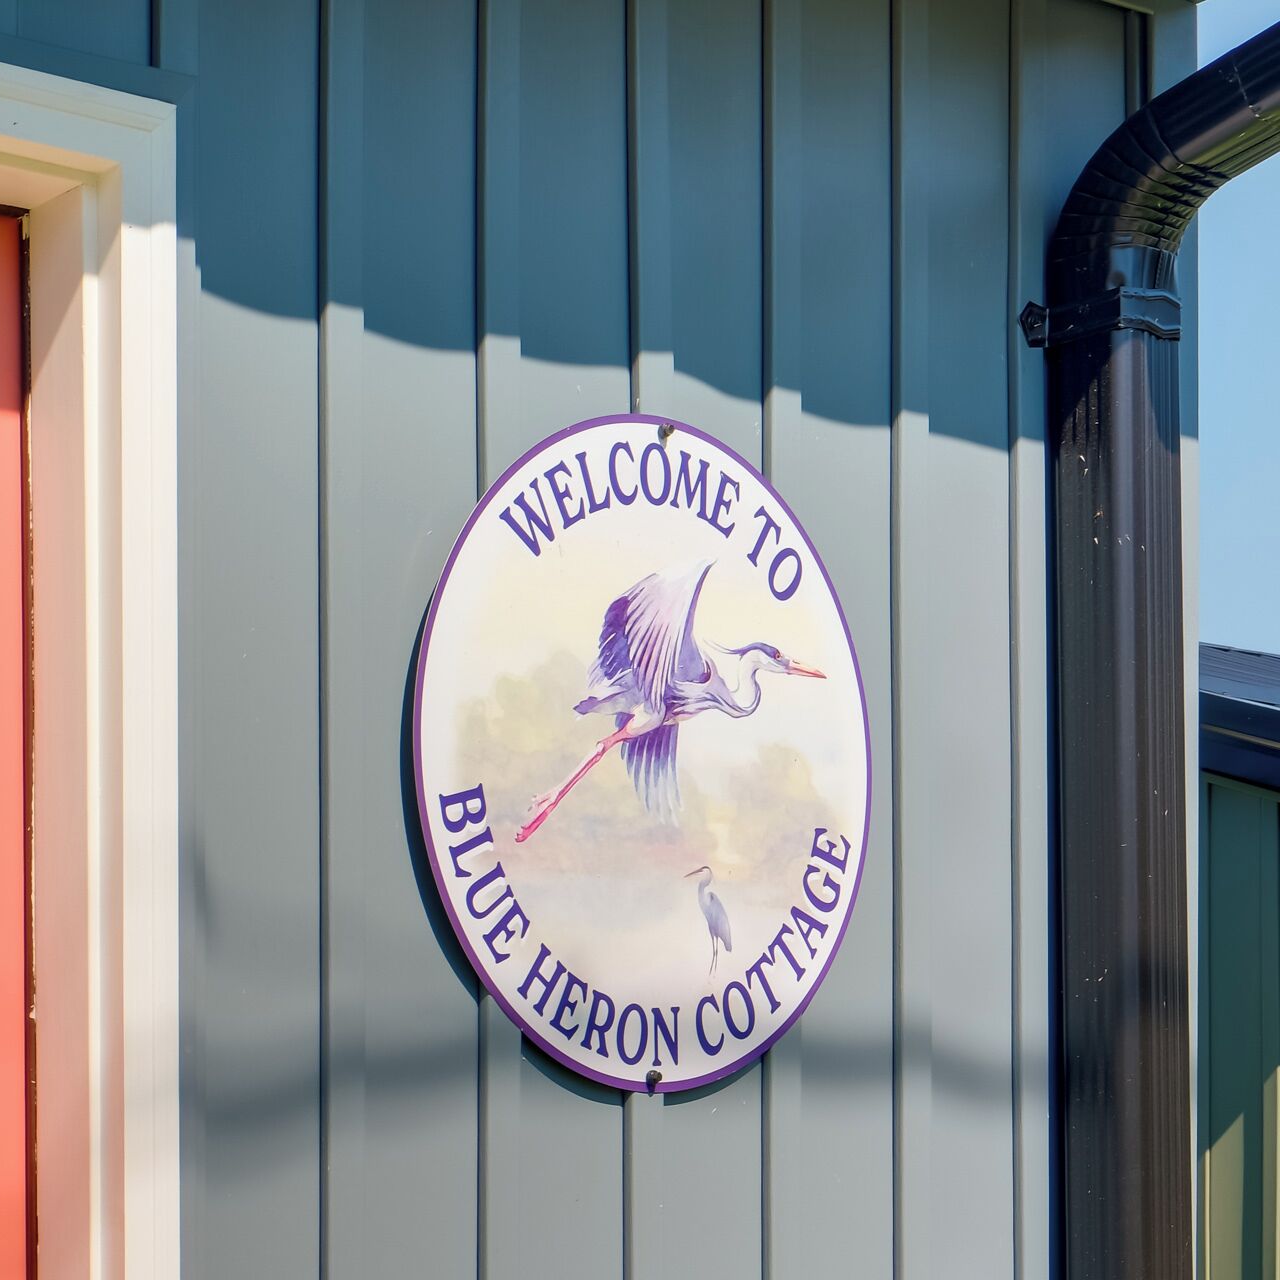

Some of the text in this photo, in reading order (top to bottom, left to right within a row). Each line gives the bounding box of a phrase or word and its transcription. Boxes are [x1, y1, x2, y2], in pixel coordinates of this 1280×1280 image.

[498, 441, 803, 602] WELCOME TO
[438, 783, 852, 1067] BLUE HERON COTTAGE
